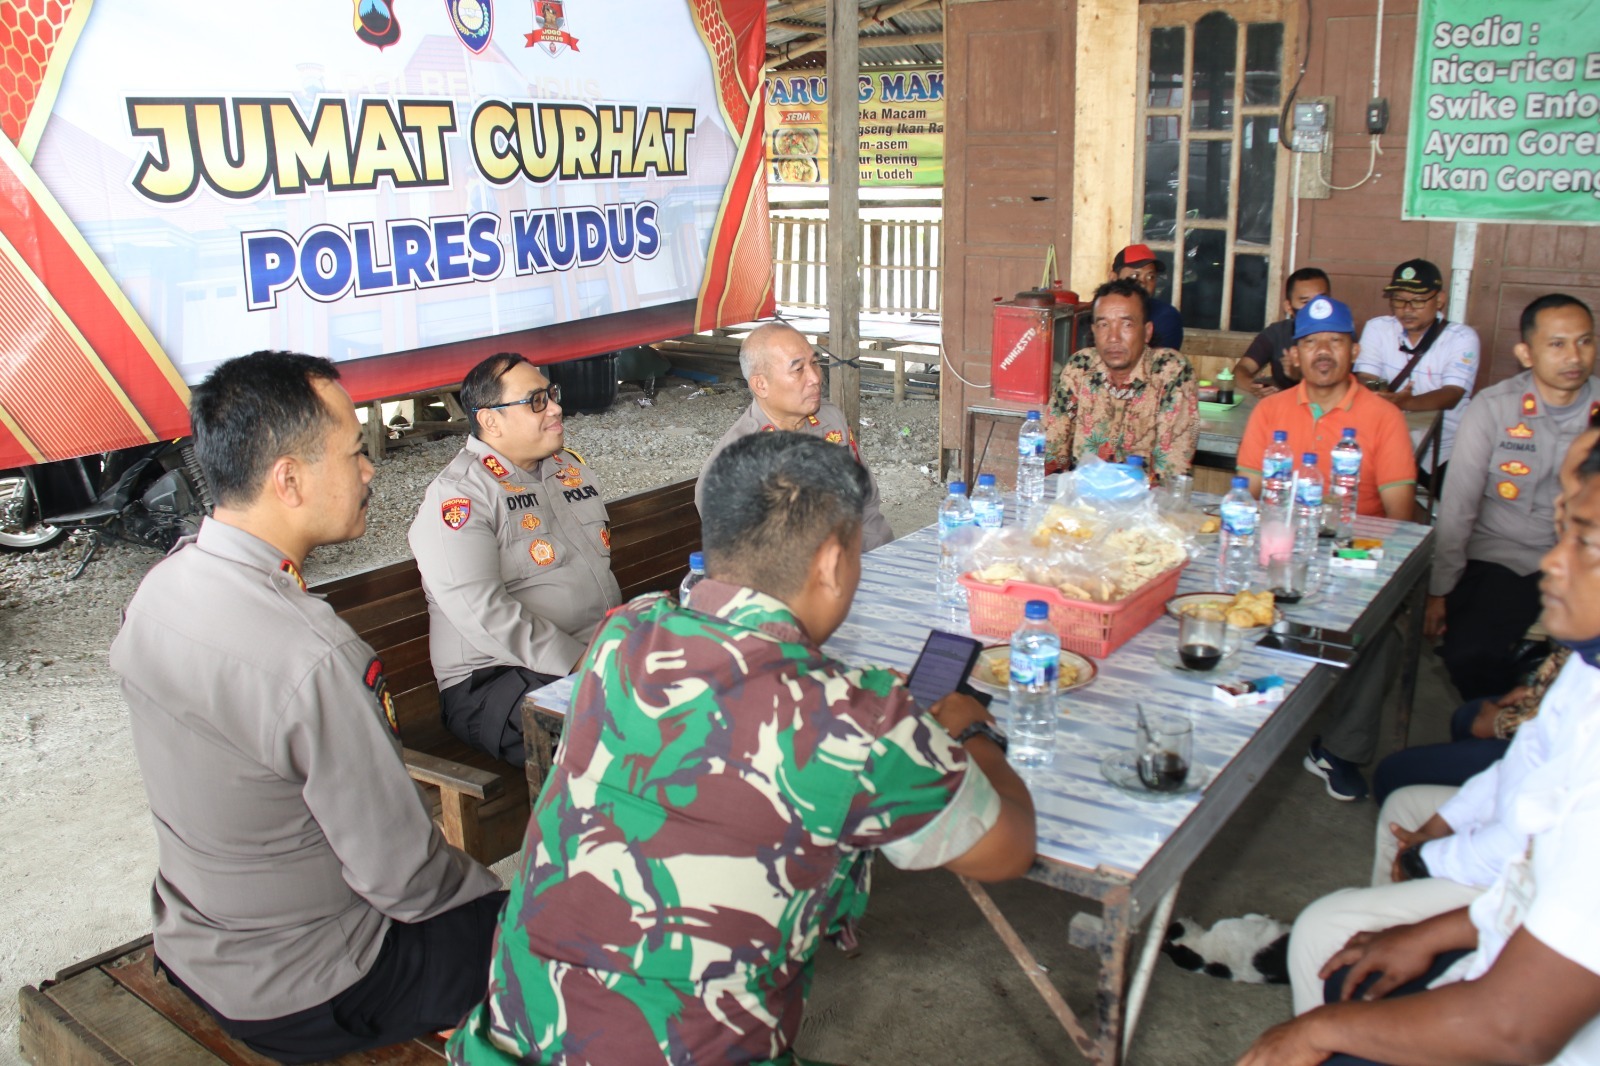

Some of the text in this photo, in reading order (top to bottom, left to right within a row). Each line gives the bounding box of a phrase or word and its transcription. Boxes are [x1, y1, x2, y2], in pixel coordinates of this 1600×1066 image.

[1433, 15, 1523, 48] Sedia
[1431, 51, 1577, 84] Rica-rica
[881, 108, 926, 120] Macam
[1428, 89, 1517, 120] Swike
[785, 112, 811, 121] SEDIA
[897, 123, 923, 134] Ikan
[125, 96, 696, 204] JUMAT CURHAT
[1424, 130, 1509, 163] Ayam
[875, 154, 918, 166] Bening
[876, 169, 913, 180] Lodeh
[1422, 163, 1489, 190] Ikan
[241, 200, 662, 312] POLRES KUDUS
[1499, 441, 1537, 452] ADIMAS
[506, 493, 540, 511] DYDIT
[562, 484, 599, 503] POLRI
